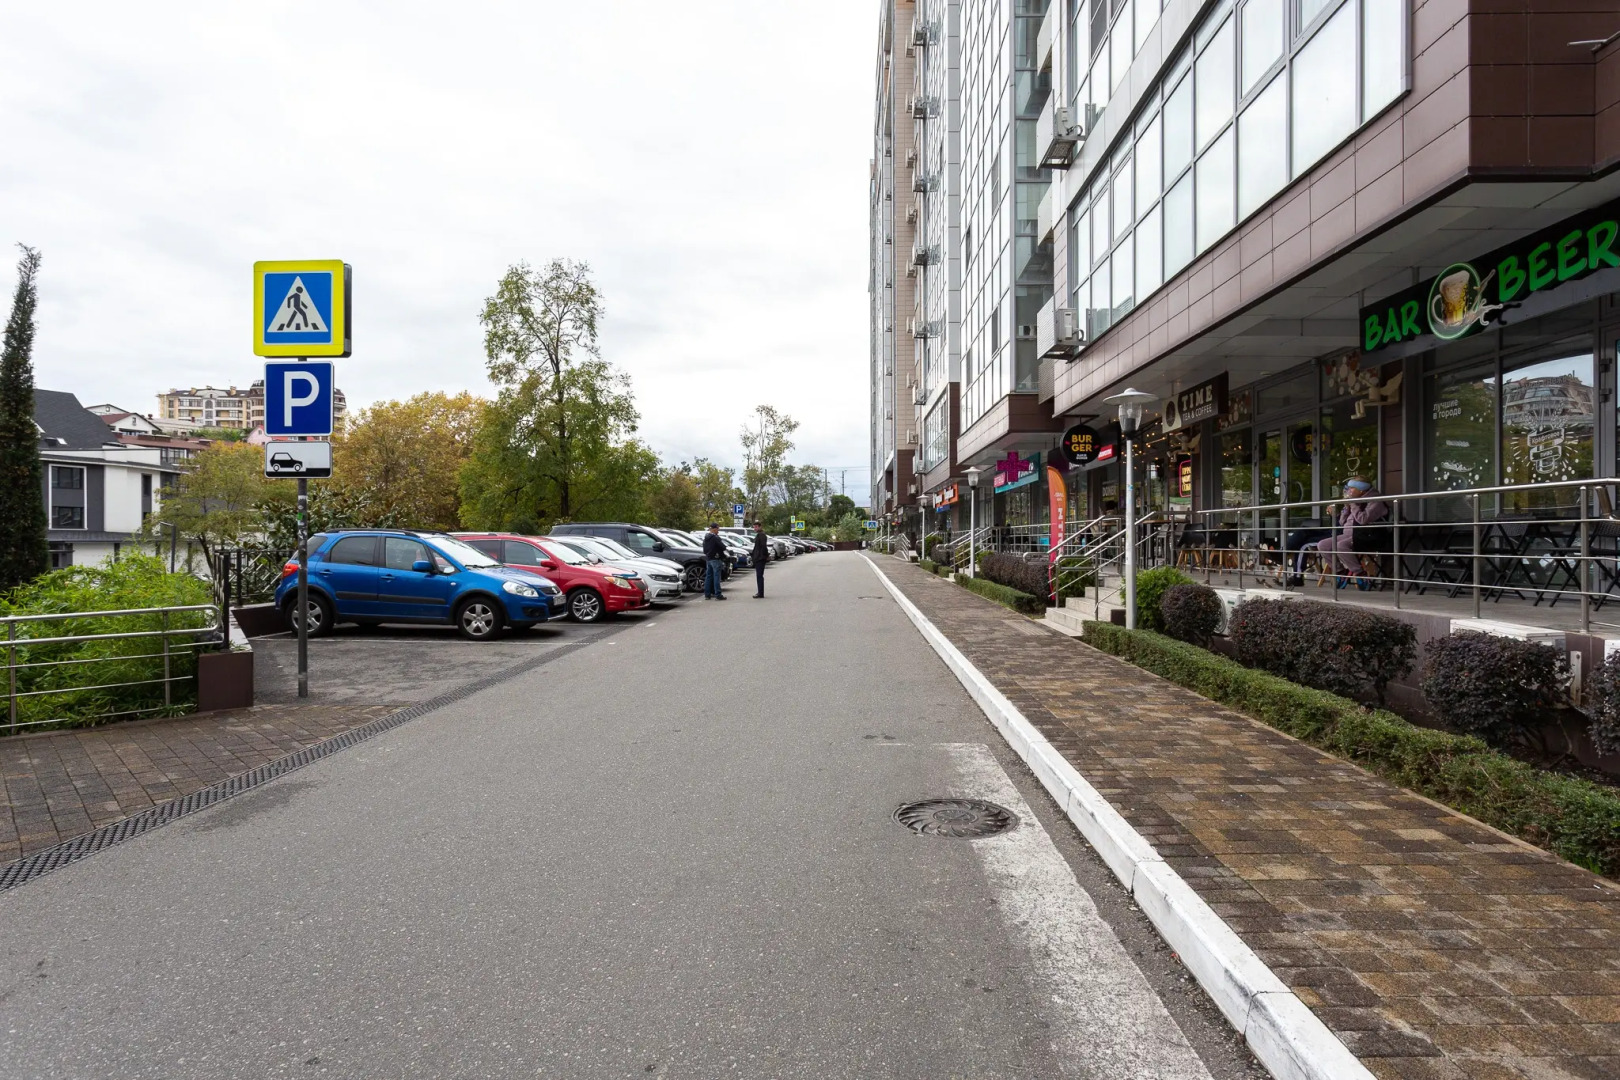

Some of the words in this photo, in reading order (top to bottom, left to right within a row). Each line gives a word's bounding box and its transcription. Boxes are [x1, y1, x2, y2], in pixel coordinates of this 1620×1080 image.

[1365, 300, 1421, 350] BAR
[1497, 220, 1620, 301] BEER
[284, 371, 320, 427] P
[1181, 385, 1213, 411] TIME
[1182, 411, 1191, 421] TEA
[1195, 404, 1212, 417] COFFEE
[1071, 434, 1092, 443] BUR
[1071, 443, 1092, 452] GER
[736, 505, 742, 513] P
